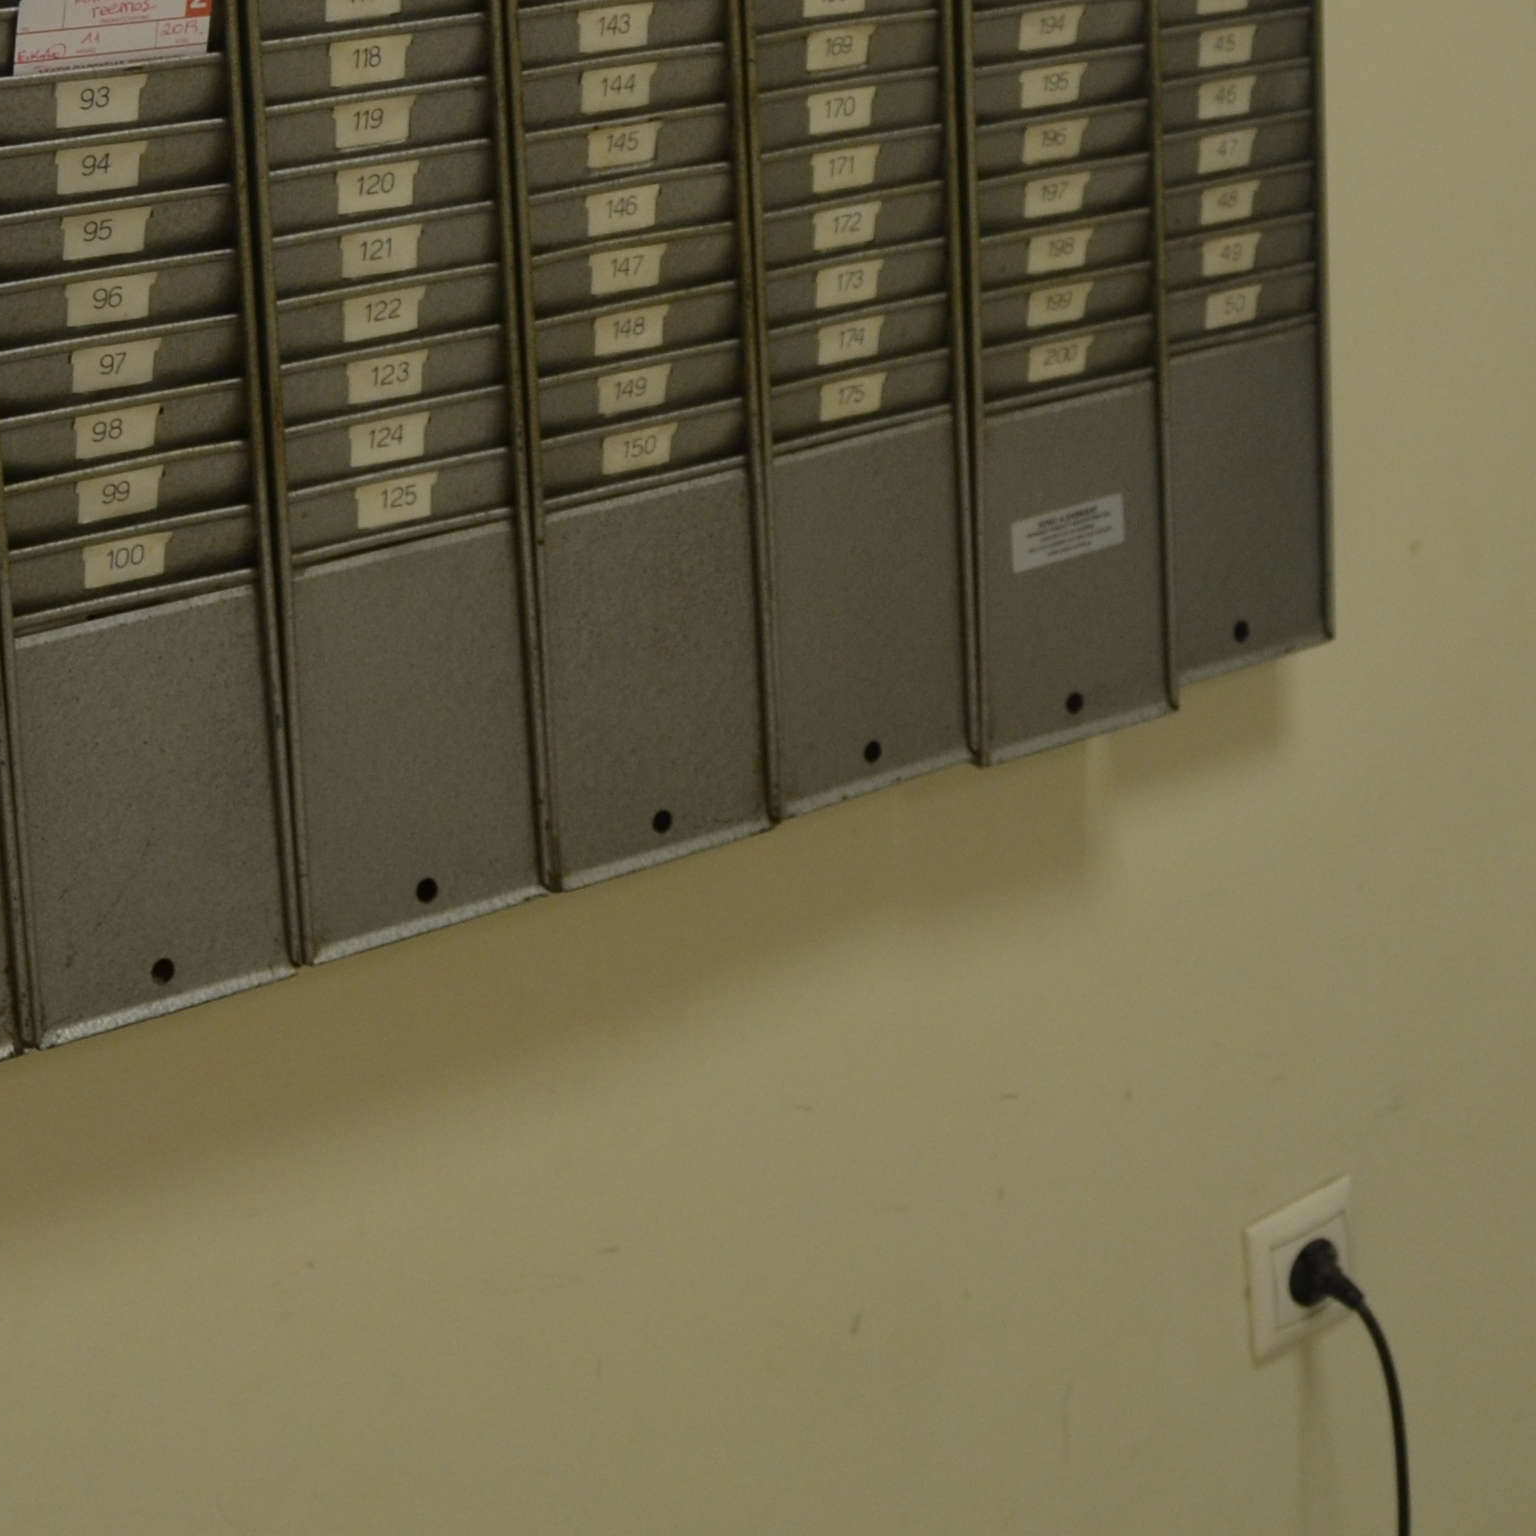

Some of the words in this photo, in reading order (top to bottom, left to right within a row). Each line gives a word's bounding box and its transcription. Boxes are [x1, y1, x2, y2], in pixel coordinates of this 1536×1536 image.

[598, 12, 631, 36] 143
[352, 45, 382, 69] 118
[81, 152, 111, 177] 94
[828, 154, 856, 178] 171
[606, 194, 639, 219] 146
[359, 237, 393, 262] 121
[92, 285, 123, 310] 96
[613, 315, 646, 340] 148
[838, 326, 866, 349] 174
[371, 360, 410, 387] 123
[92, 417, 123, 443] 98
[623, 433, 658, 459] 150
[381, 483, 418, 509] 125
[107, 543, 145, 570] 100
